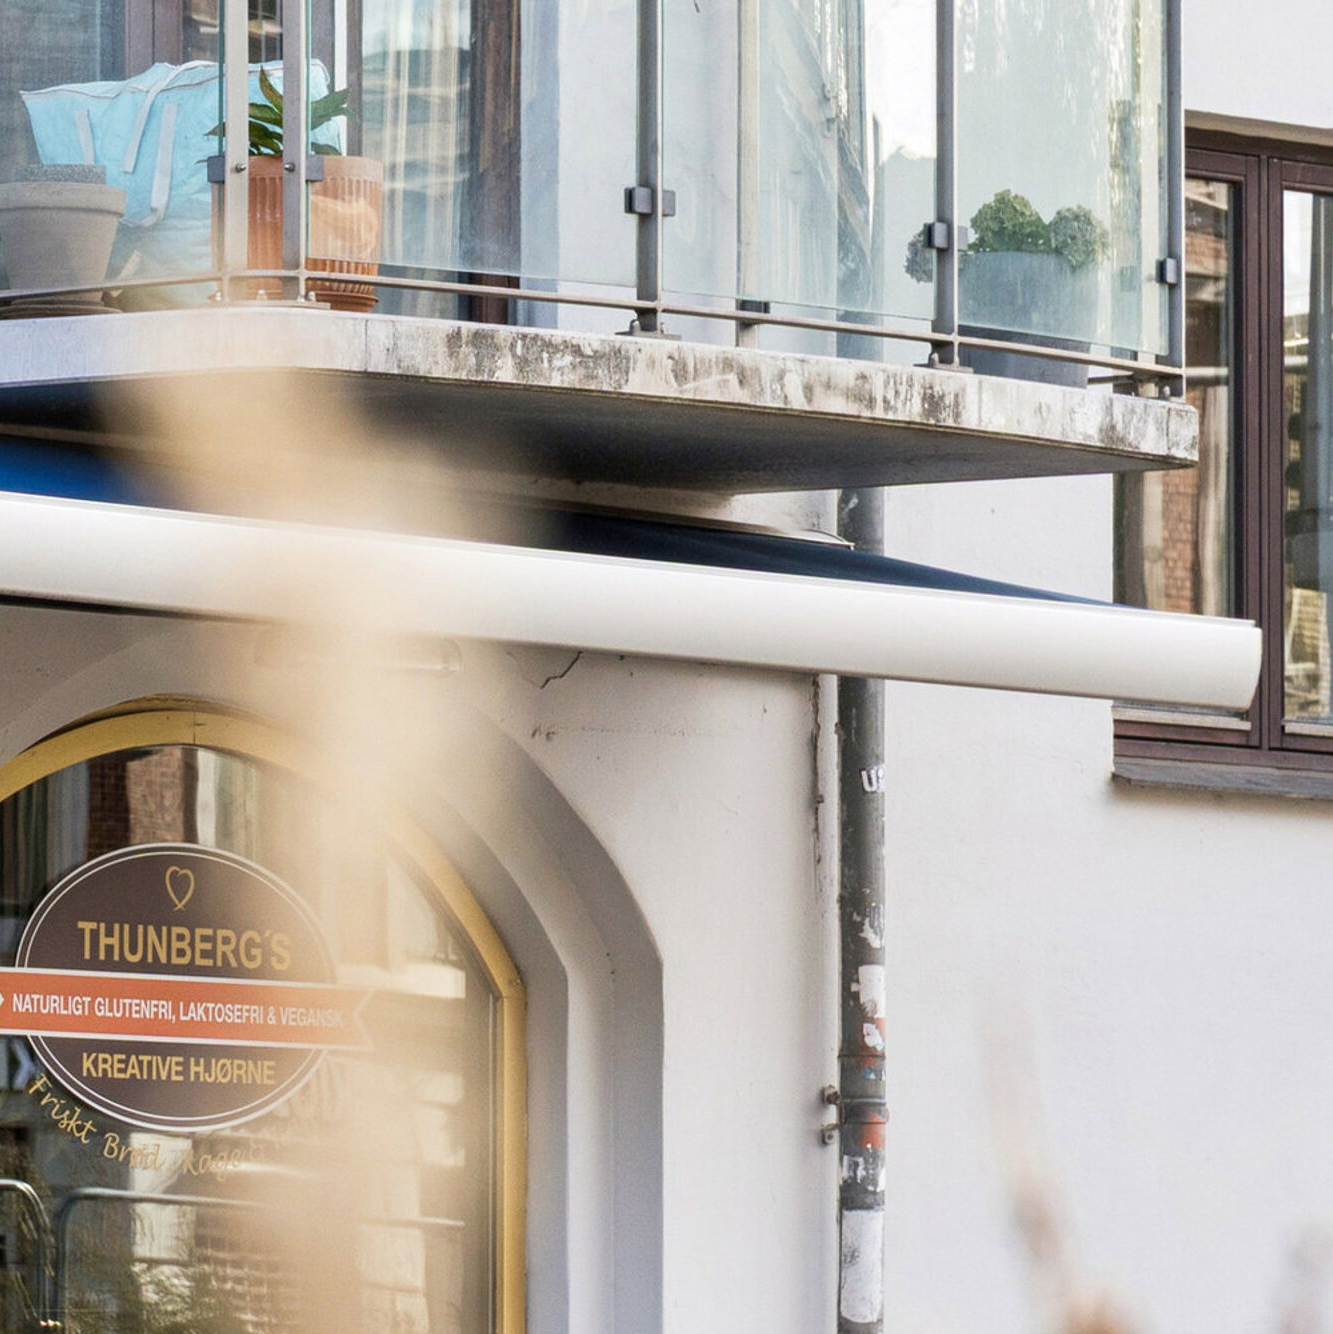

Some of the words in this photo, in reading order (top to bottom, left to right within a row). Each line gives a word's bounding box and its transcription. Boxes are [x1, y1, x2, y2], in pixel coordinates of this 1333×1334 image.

[12, 993, 91, 1016] NATURLIGT
[94, 997, 176, 1023] GLUTENFRI,
[179, 1000, 263, 1025] LAKTOSEFRI
[267, 1004, 277, 1024] &
[280, 1005, 344, 1028] VEGANSK
[82, 1052, 183, 1082] KREATIVE
[190, 1056, 276, 1086] HJØRNE
[28, 1073, 96, 1144] Friskt
